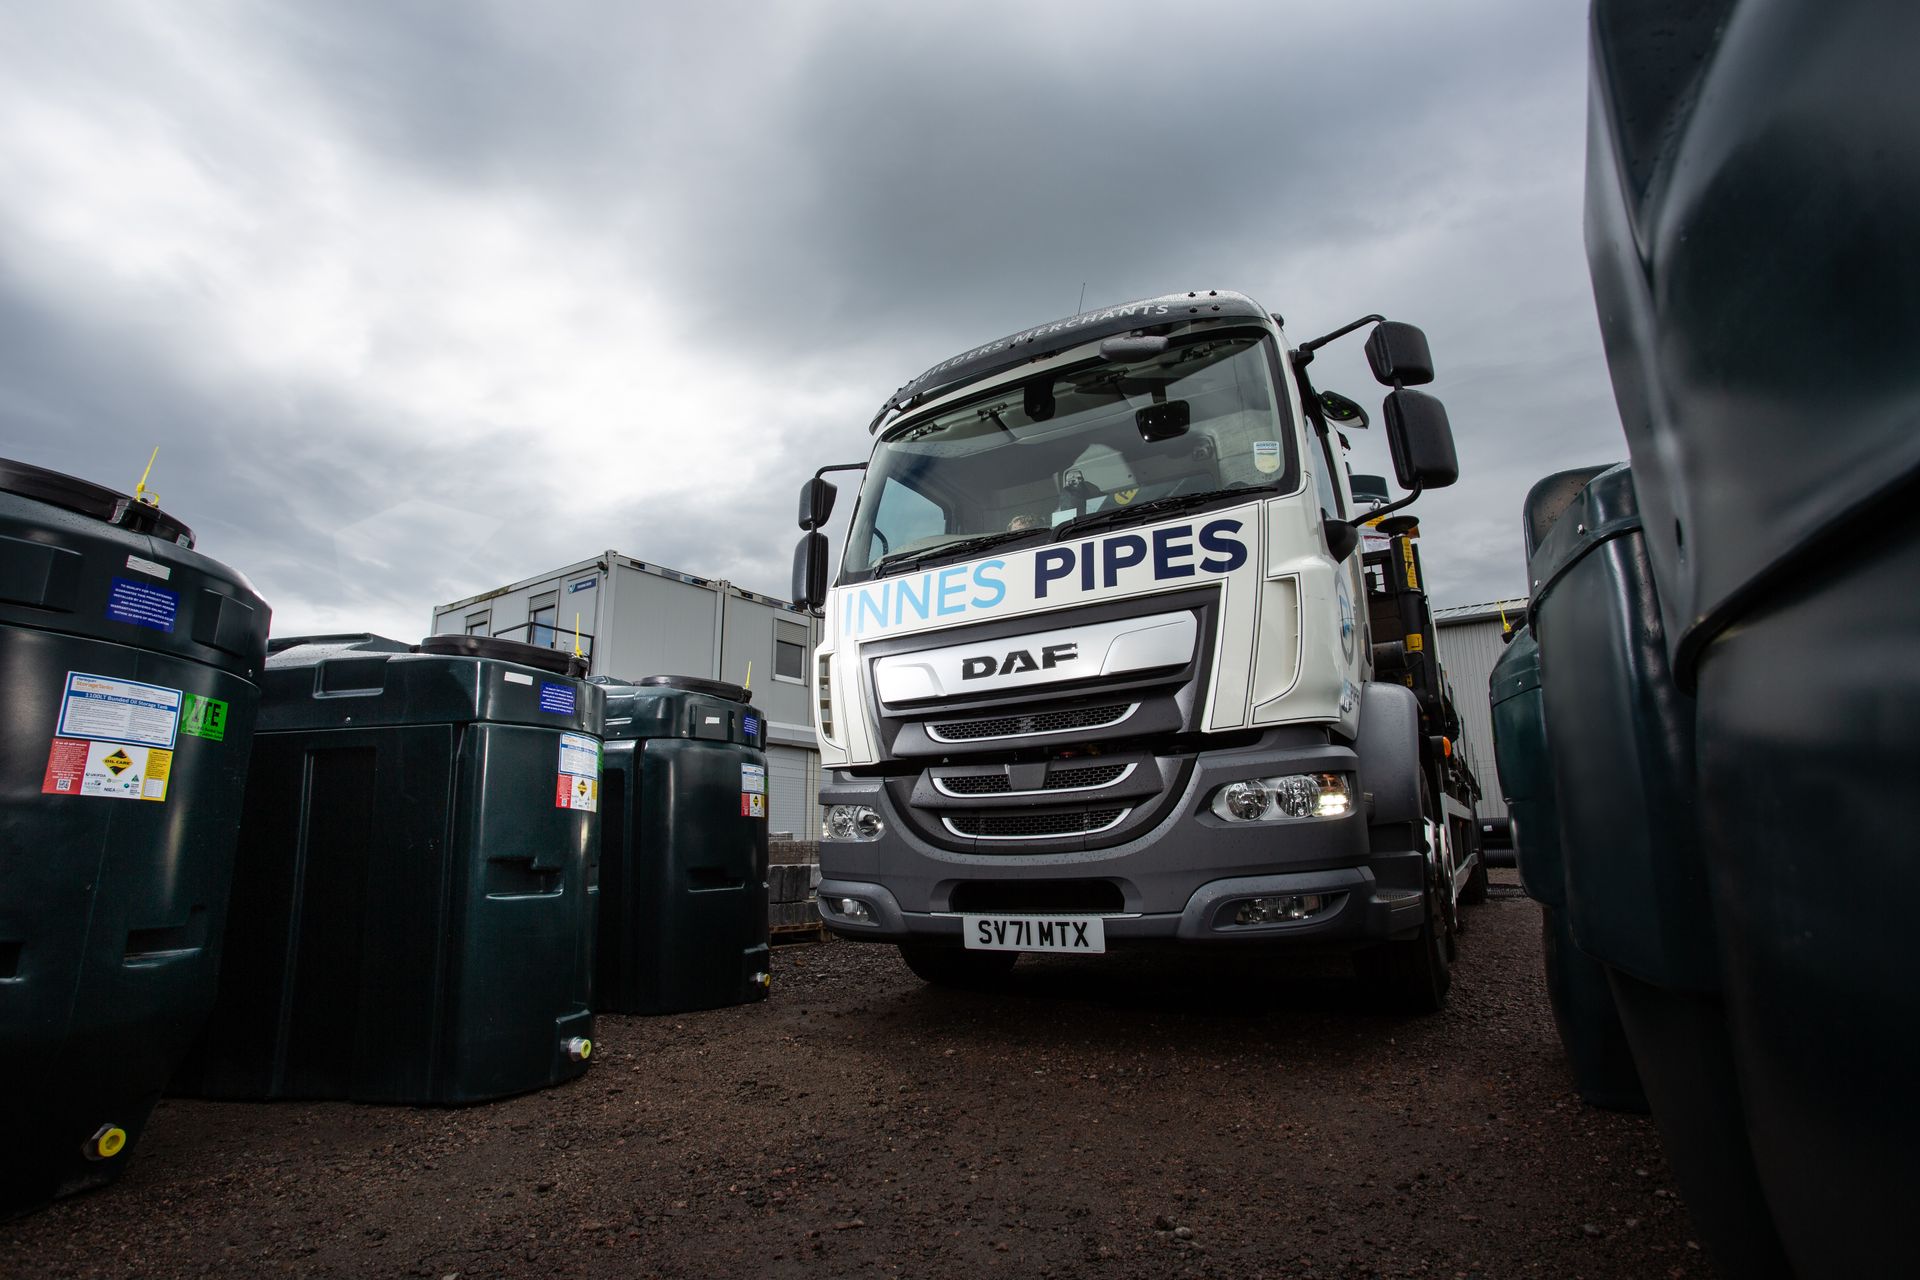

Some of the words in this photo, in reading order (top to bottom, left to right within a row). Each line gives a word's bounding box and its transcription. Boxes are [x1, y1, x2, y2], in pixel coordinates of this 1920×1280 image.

[906, 340, 1007, 392] BUILDERS
[1013, 303, 1170, 344] MERCHANTS
[844, 559, 1006, 637] INNES
[1034, 519, 1248, 600] PIPES
[961, 642, 1079, 681] DAF
[978, 920, 1032, 946] SV71
[1038, 921, 1090, 948] MTX
